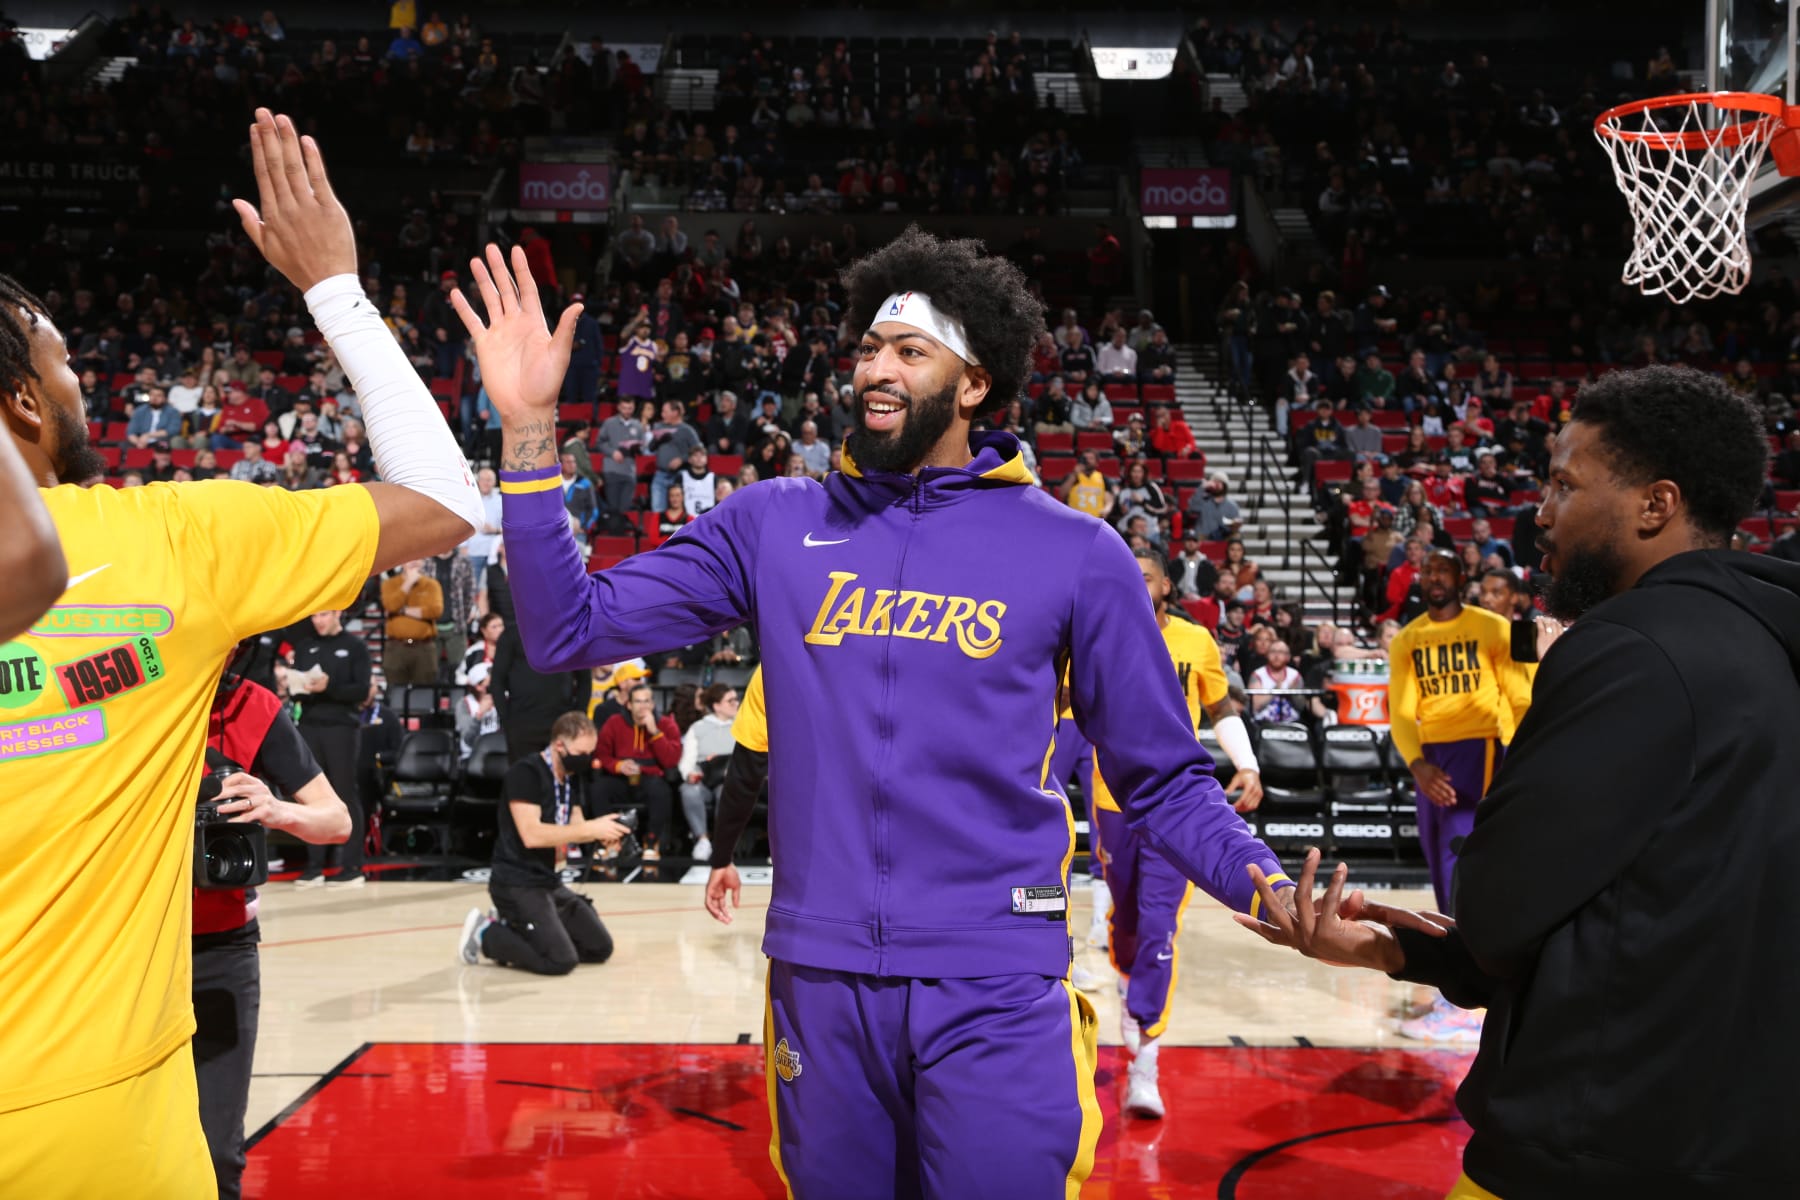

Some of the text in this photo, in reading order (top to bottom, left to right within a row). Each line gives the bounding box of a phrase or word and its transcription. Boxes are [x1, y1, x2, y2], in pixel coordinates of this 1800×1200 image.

[68, 163, 141, 180] TRUCK
[524, 169, 606, 199] moda
[1145, 175, 1226, 205] moda
[36, 612, 162, 628] JUSTICE
[804, 571, 1008, 659] LAKERS
[139, 637, 160, 679] OCT. 31
[1411, 639, 1481, 678] BLACK
[0, 656, 43, 695] OTE
[63, 647, 139, 704] 1950
[28, 715, 90, 737] BLACK
[1261, 728, 1308, 741] GEICO
[1326, 729, 1373, 742] GEICO
[1, 732, 78, 755] NESSES
[1265, 823, 1325, 837] GEICO
[1332, 823, 1393, 838] GEICO
